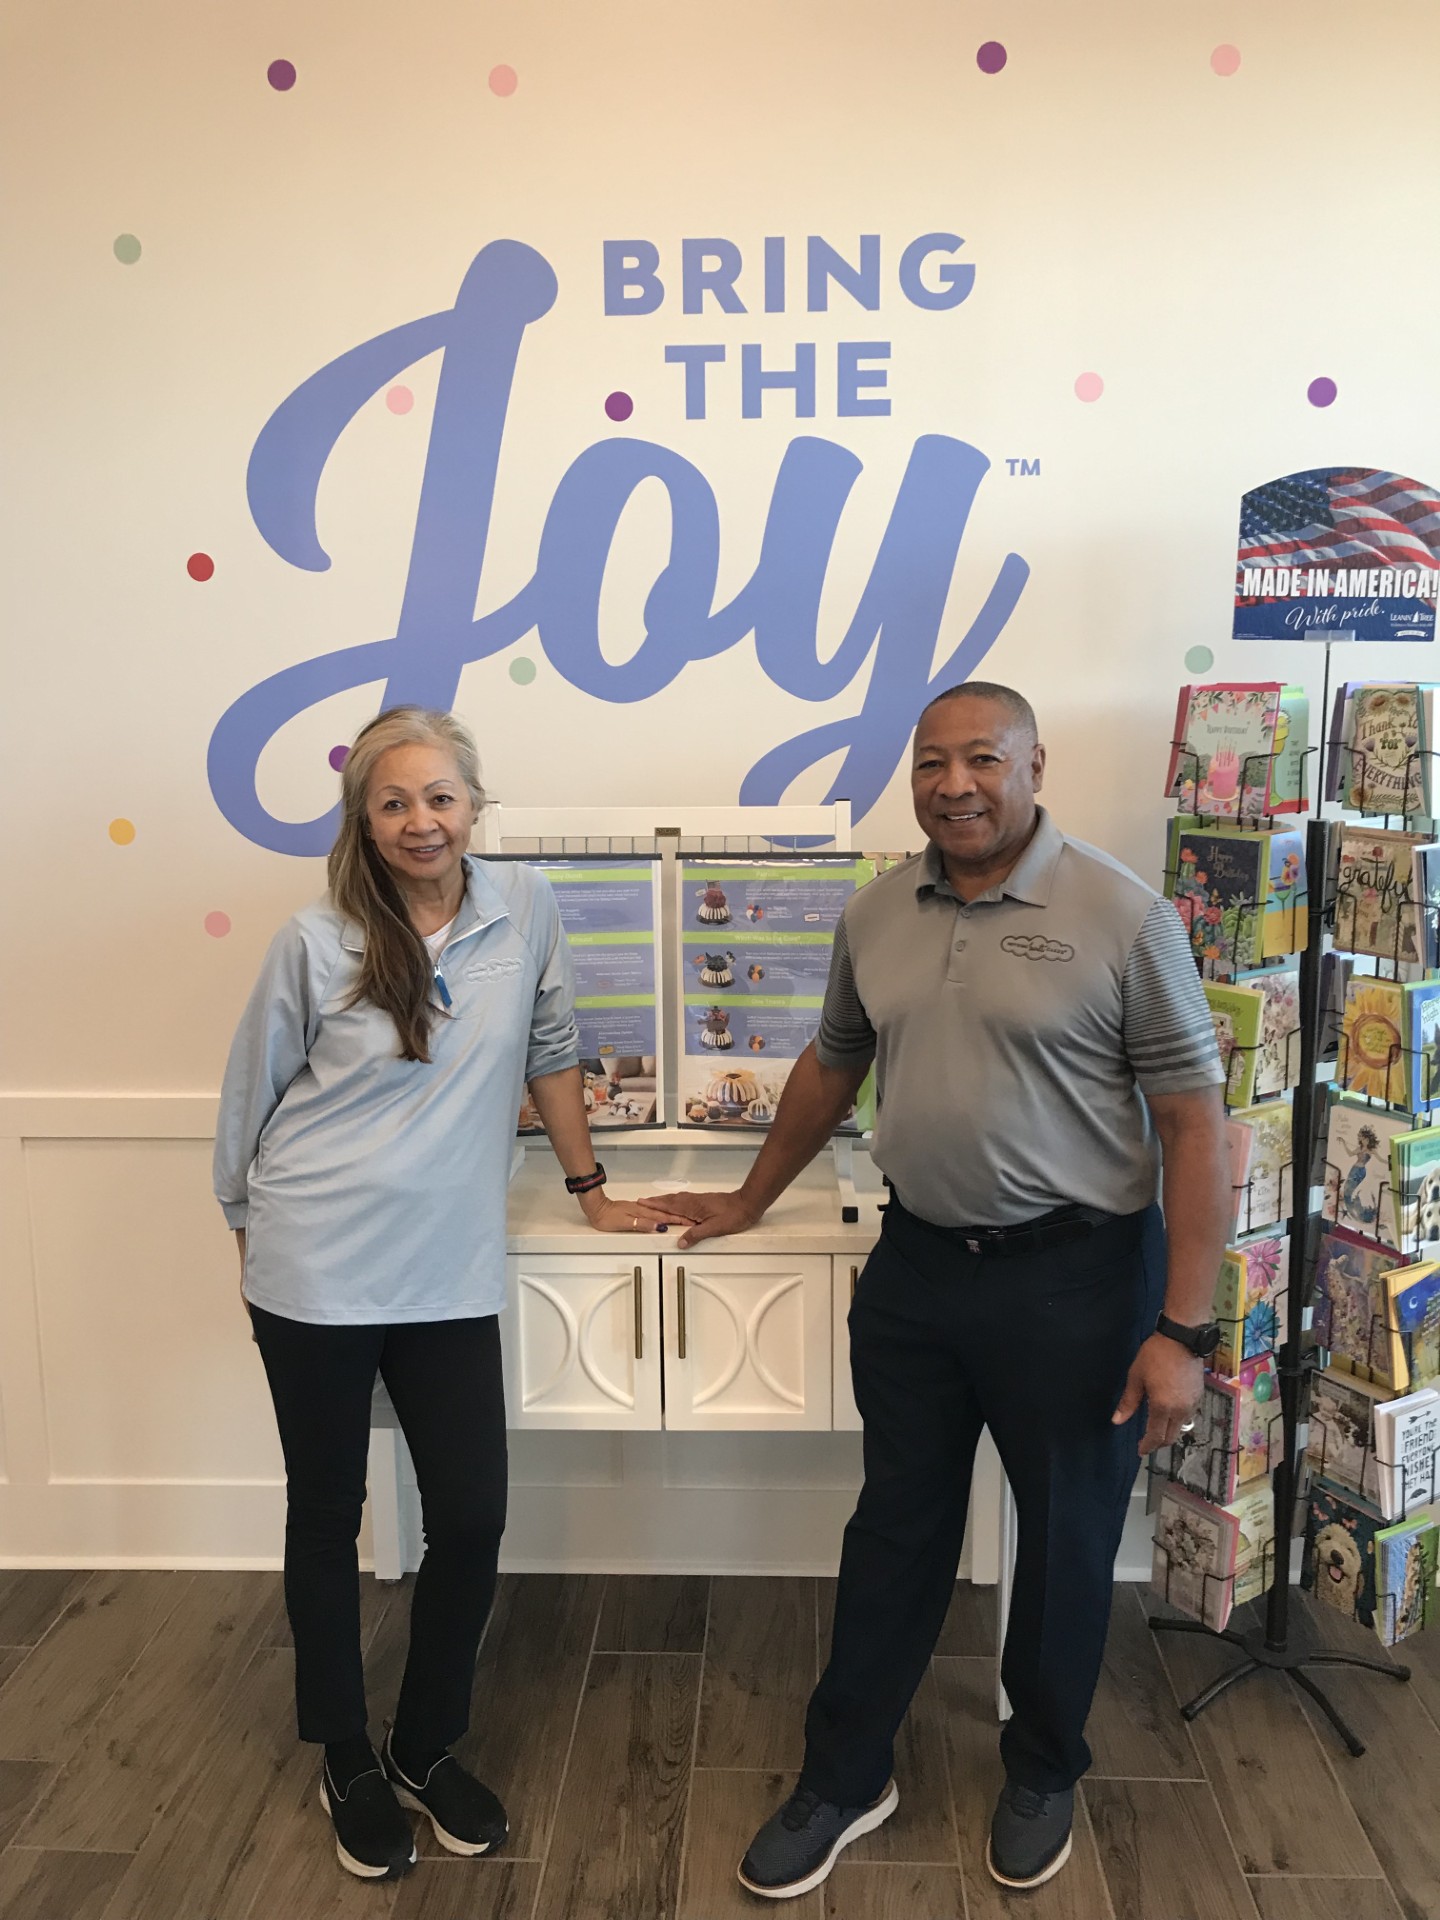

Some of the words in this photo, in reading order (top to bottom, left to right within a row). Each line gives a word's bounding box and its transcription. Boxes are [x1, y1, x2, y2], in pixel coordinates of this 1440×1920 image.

[603, 233, 976, 315] BRING
[665, 342, 892, 419] THE
[207, 240, 1030, 857] Joy
[1243, 568, 1301, 596] MADE
[1307, 568, 1329, 597] IN
[1332, 569, 1439, 598] AMERICA!
[1285, 606, 1338, 630] With
[1340, 599, 1386, 628] pride.
[1359, 715, 1396, 740] Thank
